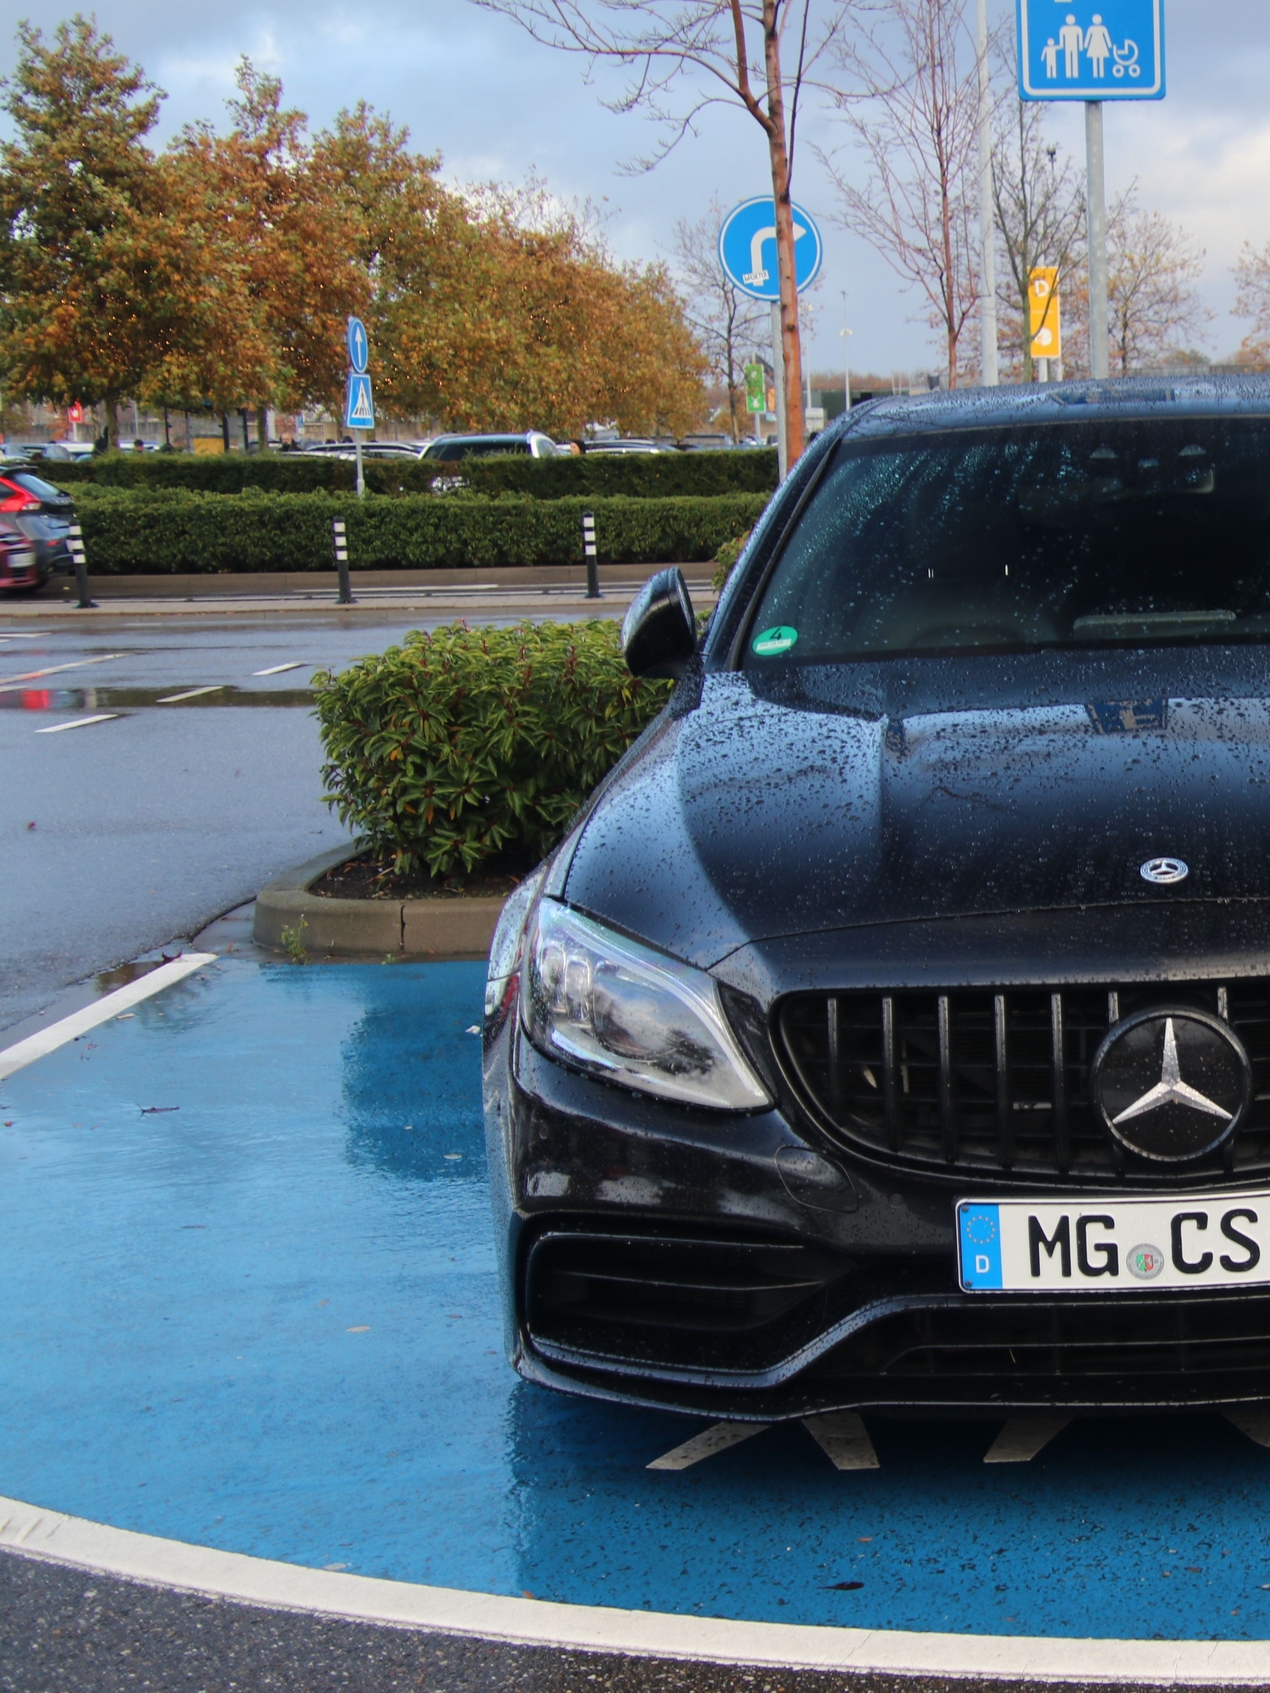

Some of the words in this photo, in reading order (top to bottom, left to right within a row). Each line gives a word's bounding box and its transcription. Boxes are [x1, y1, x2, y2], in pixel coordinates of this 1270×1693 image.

[1034, 279, 1050, 297] D
[769, 627, 783, 640] 4
[1028, 1214, 1119, 1277] MG
[1170, 1207, 1261, 1274] CS
[976, 1255, 990, 1273] D
